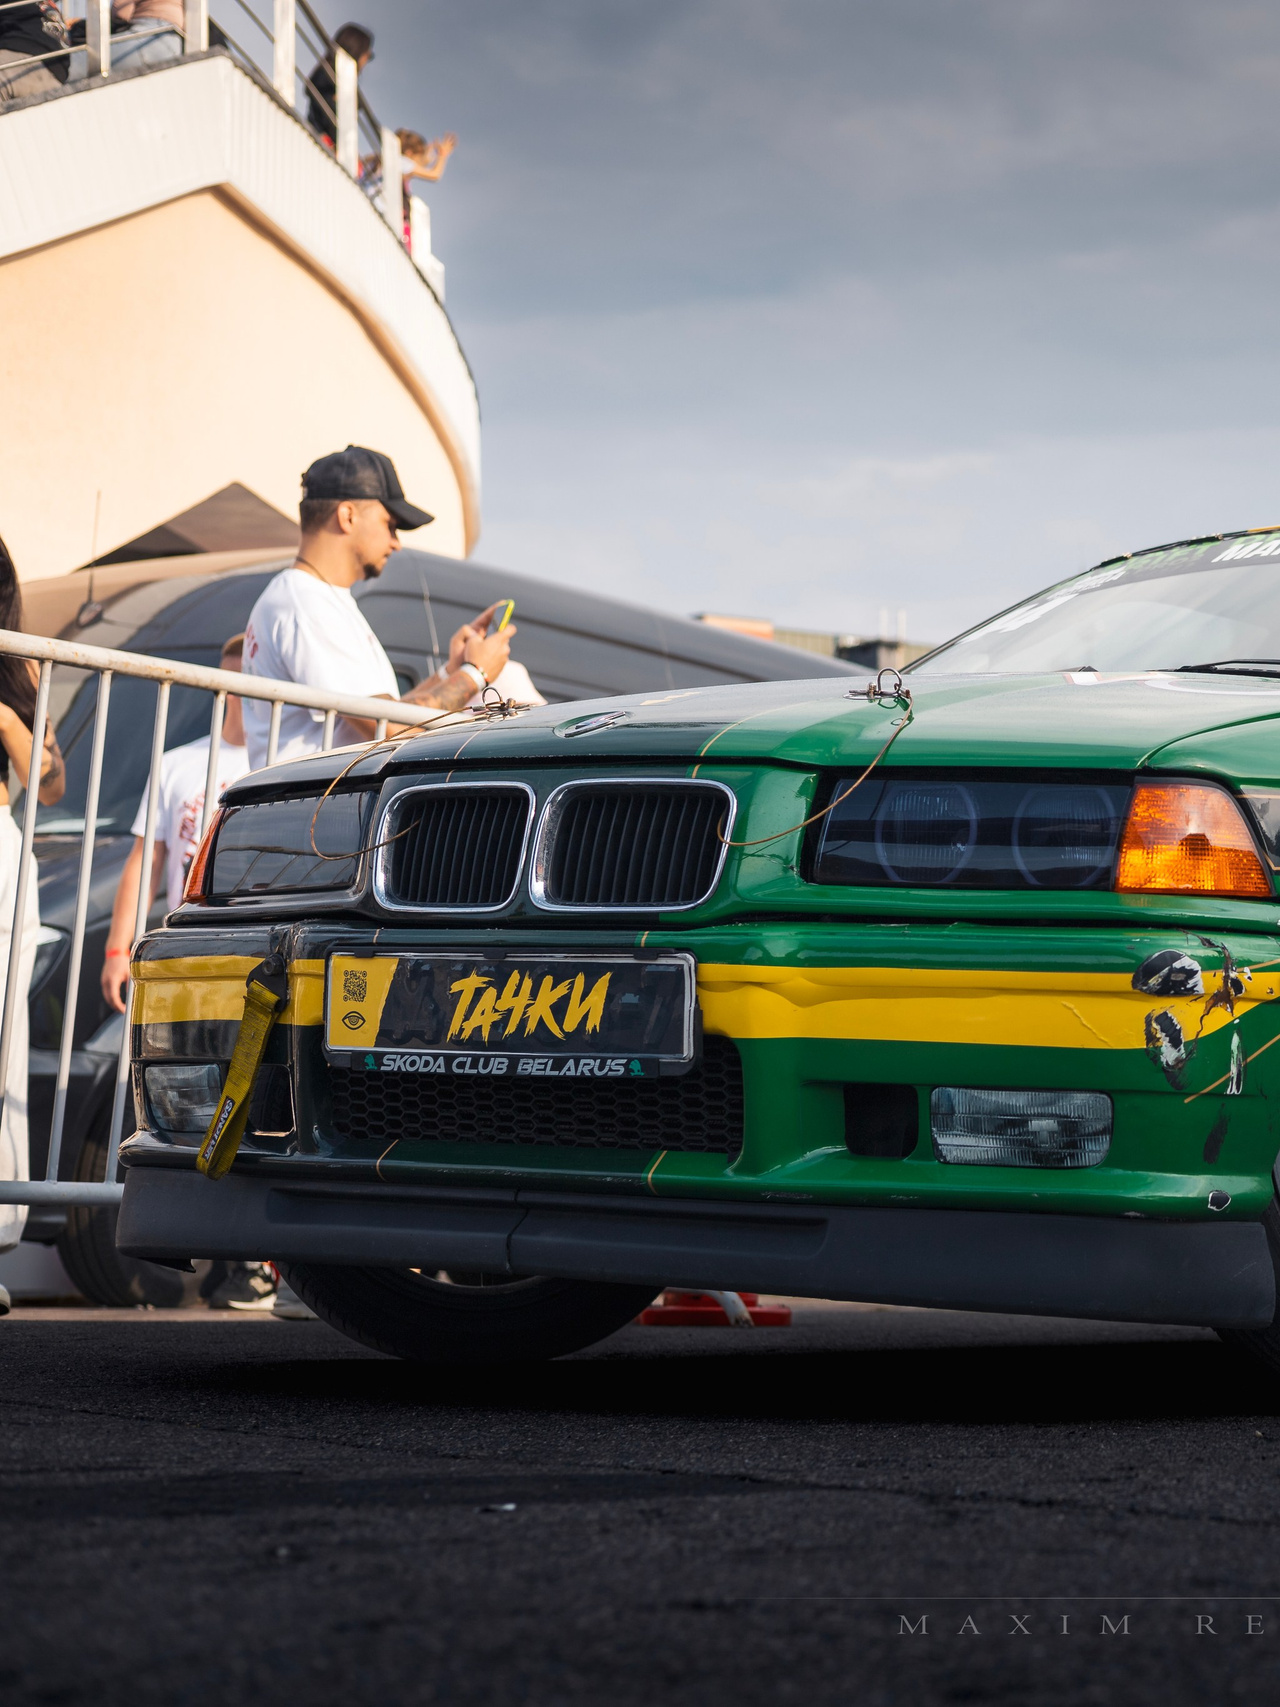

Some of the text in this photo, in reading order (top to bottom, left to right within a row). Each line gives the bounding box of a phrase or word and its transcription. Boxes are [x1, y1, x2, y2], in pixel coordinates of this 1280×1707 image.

[446, 966, 614, 1046] ТАЧКИ
[380, 1054, 628, 1076] SKODA CLUB BELARUS
